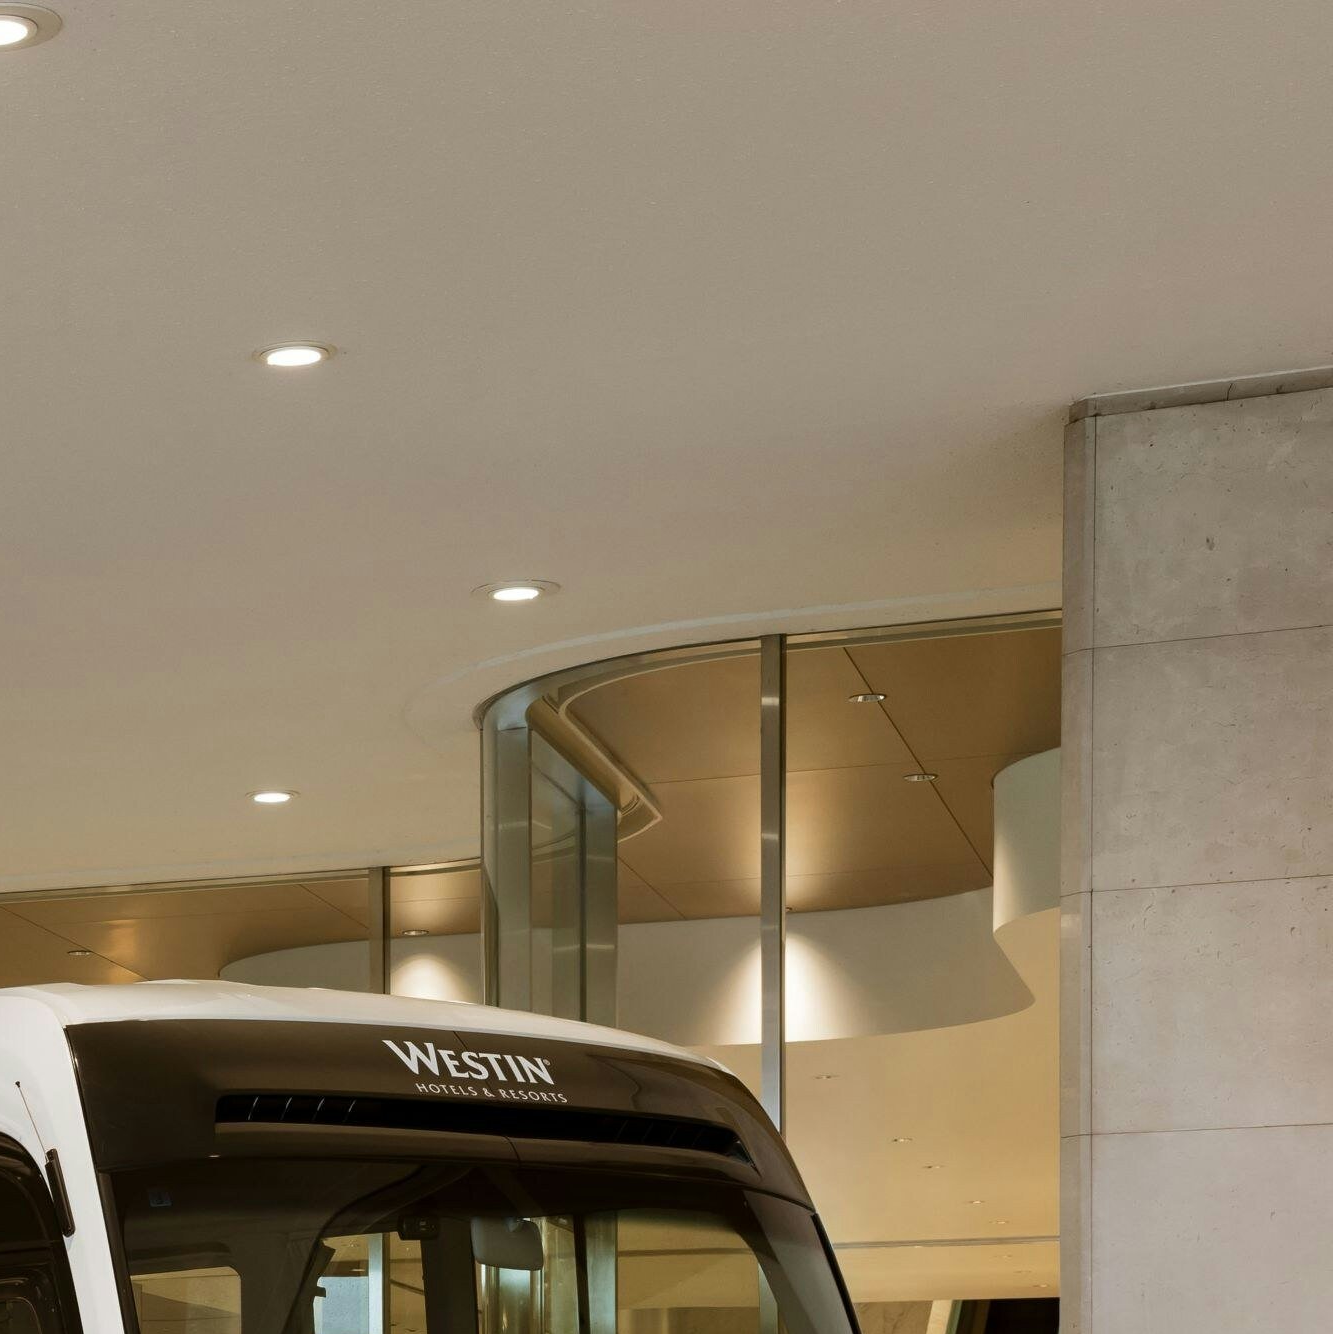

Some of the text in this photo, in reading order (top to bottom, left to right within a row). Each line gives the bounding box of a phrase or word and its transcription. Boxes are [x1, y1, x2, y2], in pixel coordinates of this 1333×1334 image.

[415, 1083, 568, 1103] HOTELS & RESORTS
